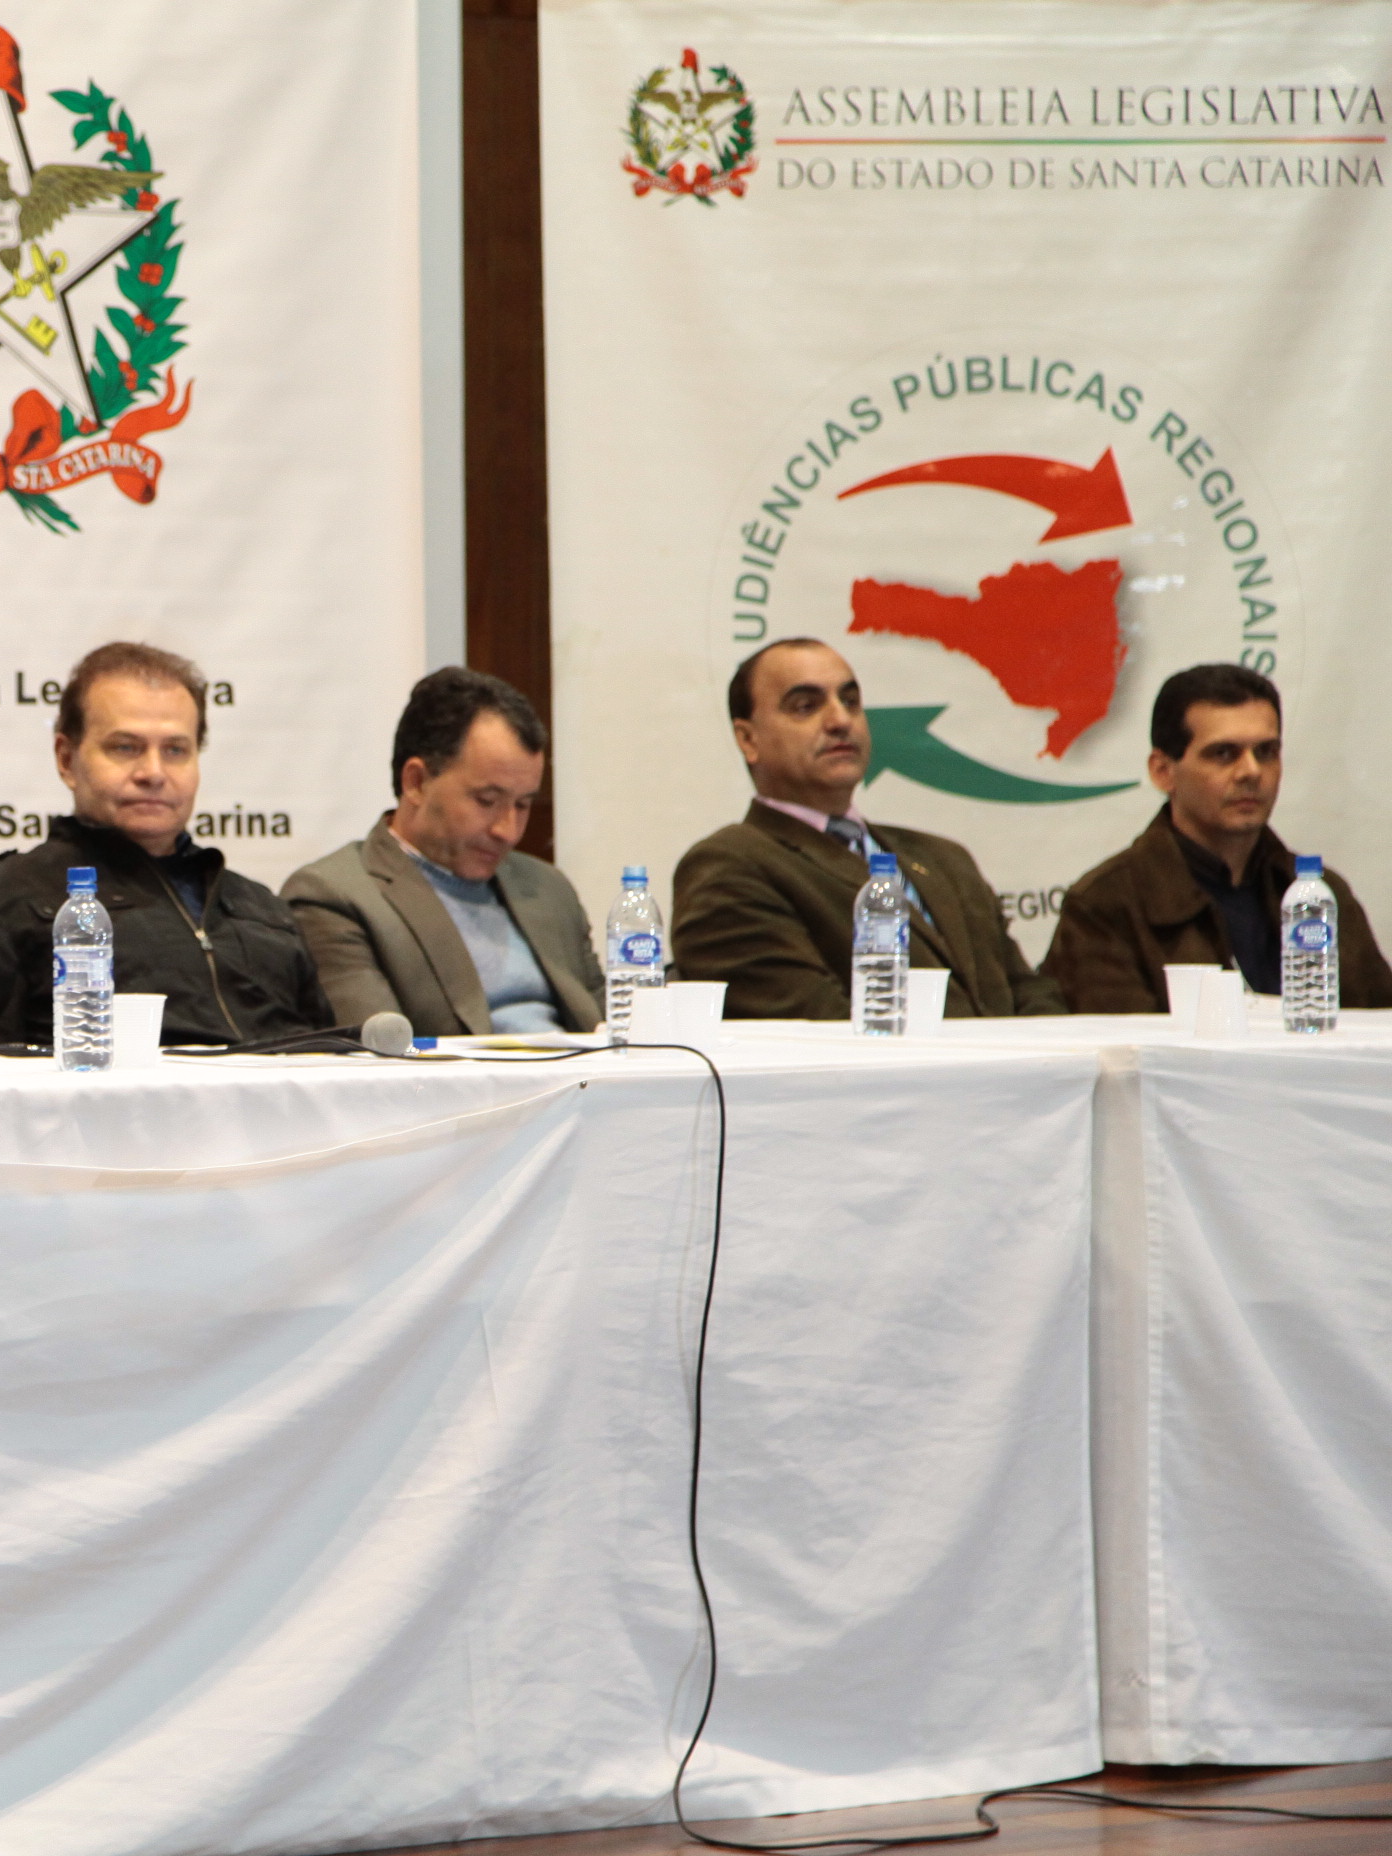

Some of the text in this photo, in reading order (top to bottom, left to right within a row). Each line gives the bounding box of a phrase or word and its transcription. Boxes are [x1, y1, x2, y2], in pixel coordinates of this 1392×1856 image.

[782, 85, 1386, 126] ASSEMBLEIA LEGISLATIVA
[776, 157, 837, 190] DO
[850, 156, 994, 190] ESTADO
[1009, 157, 1055, 190] DE
[1069, 155, 1187, 189] SANTA
[1200, 155, 1385, 188] CATARINA
[58, 442, 156, 480] CATARINA
[732, 352, 1277, 674] UDIÊNCIAS PÚBLICAS REGIONAIS
